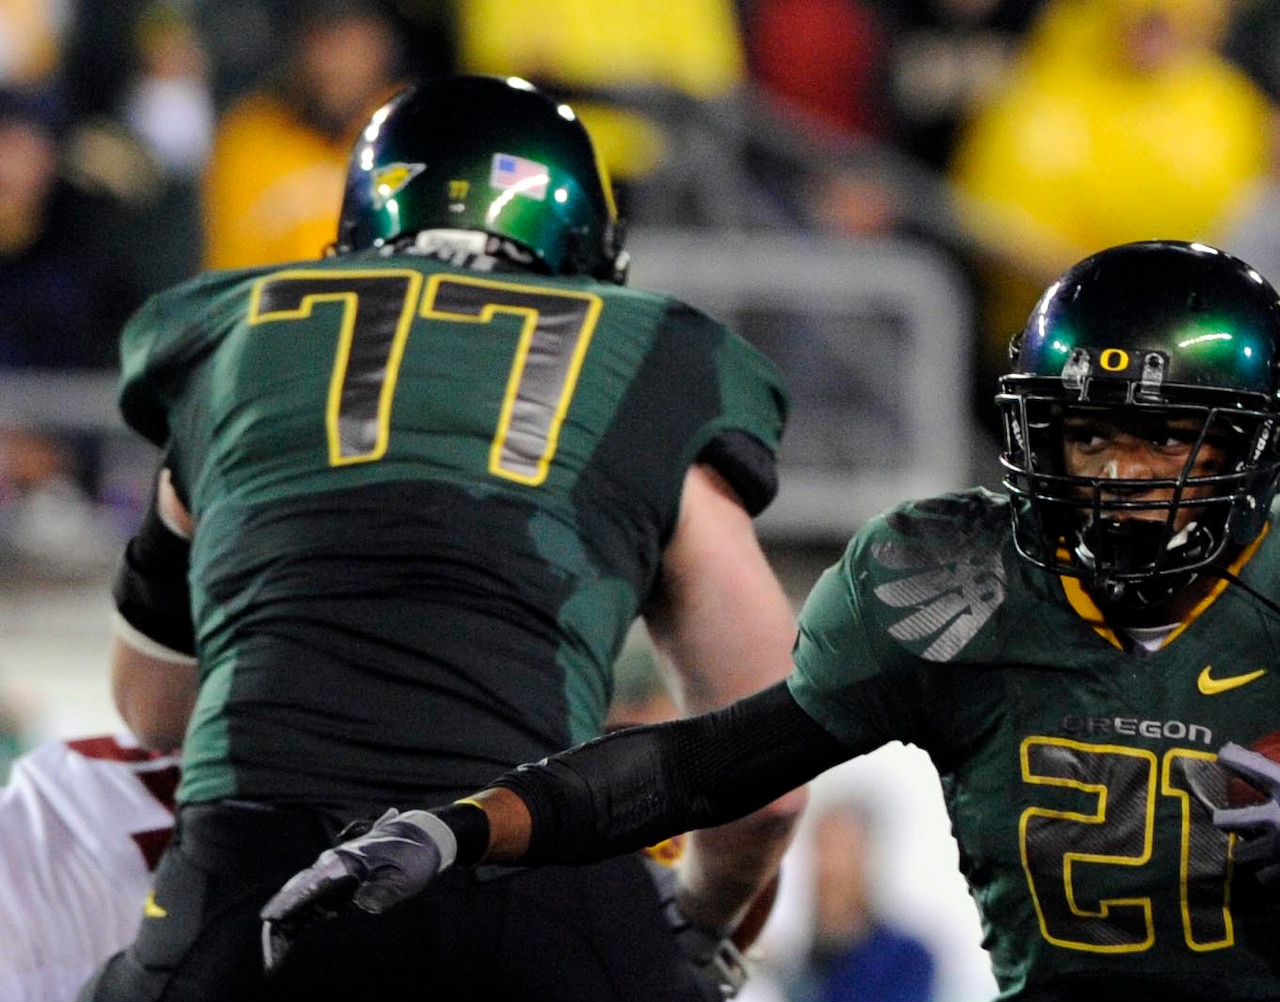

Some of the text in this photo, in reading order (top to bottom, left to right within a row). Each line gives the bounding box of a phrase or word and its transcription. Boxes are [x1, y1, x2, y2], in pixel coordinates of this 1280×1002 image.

[246, 269, 603, 487] 77
[1100, 348, 1129, 372] O
[1062, 715, 1213, 745] OREGON
[1019, 736, 1236, 954] 21
